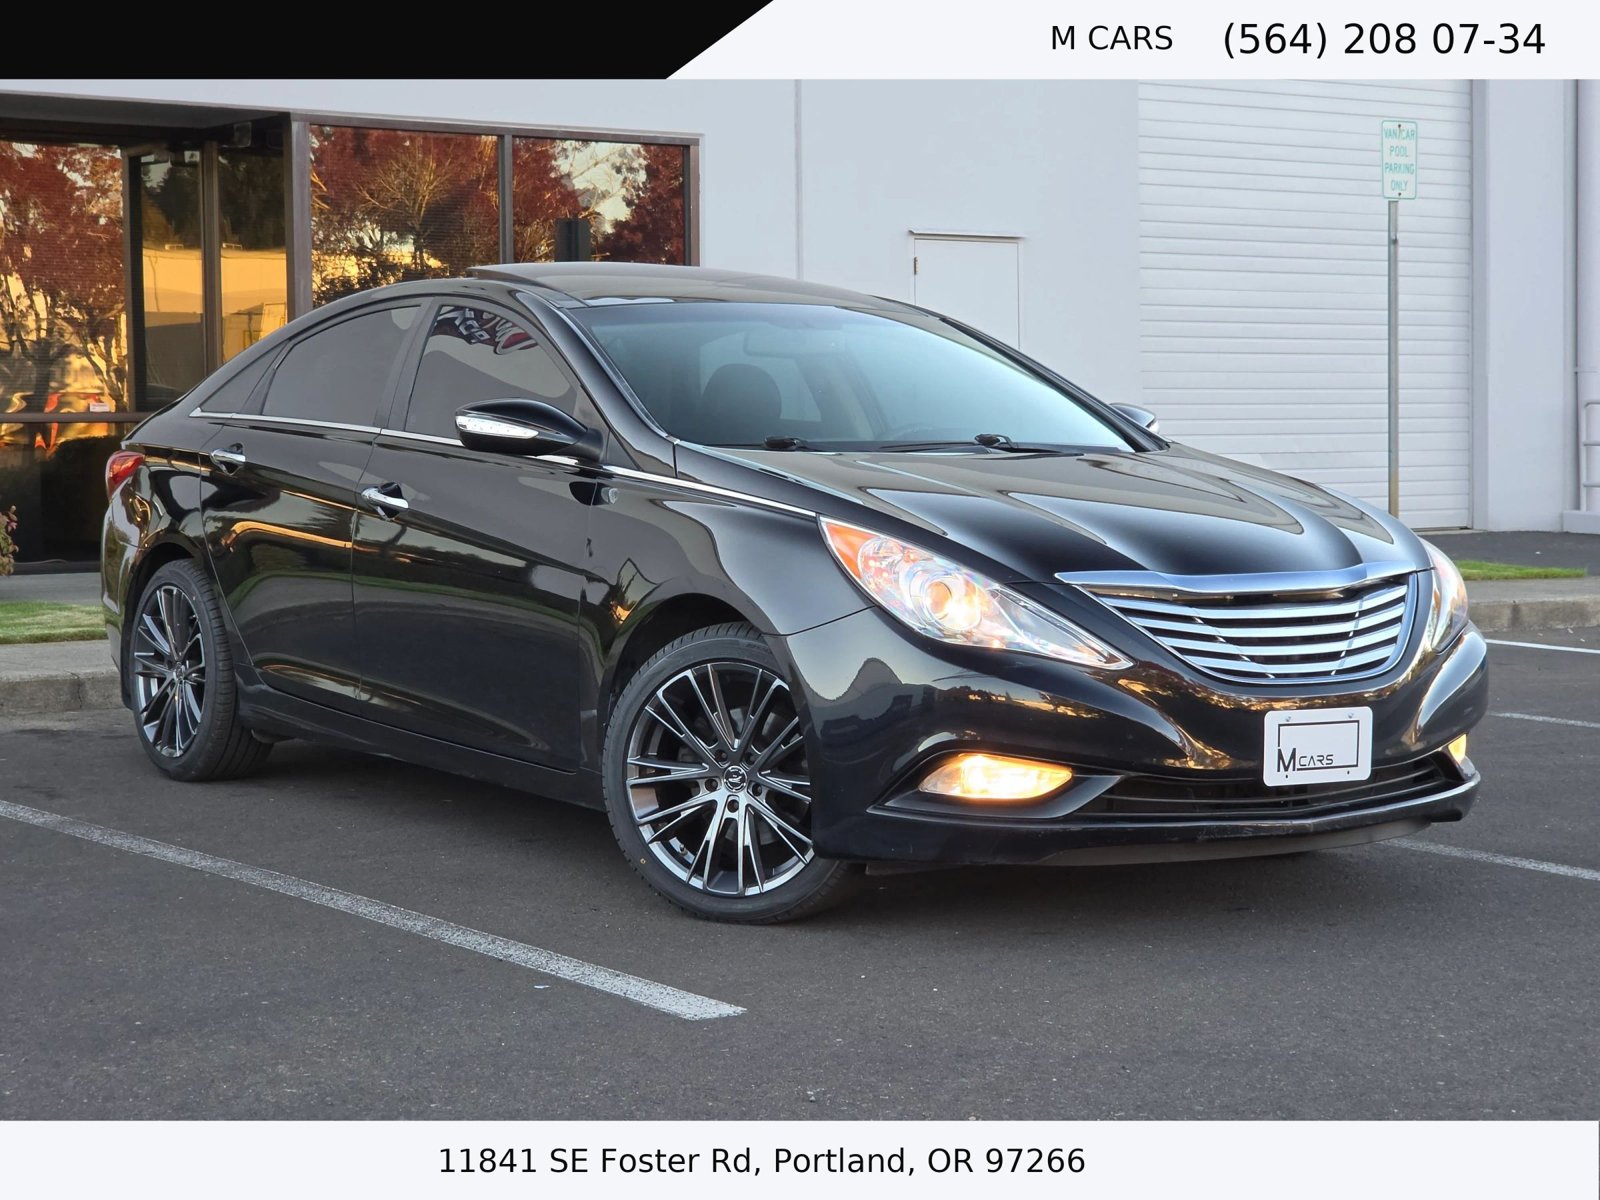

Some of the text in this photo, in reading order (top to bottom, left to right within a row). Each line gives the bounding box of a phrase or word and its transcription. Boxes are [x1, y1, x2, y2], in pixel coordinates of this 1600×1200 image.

[1390, 146, 1408, 157] POOL
[1384, 162, 1415, 175] PARKING
[1391, 180, 1408, 191] ONLY
[1298, 754, 1334, 767] CARS
